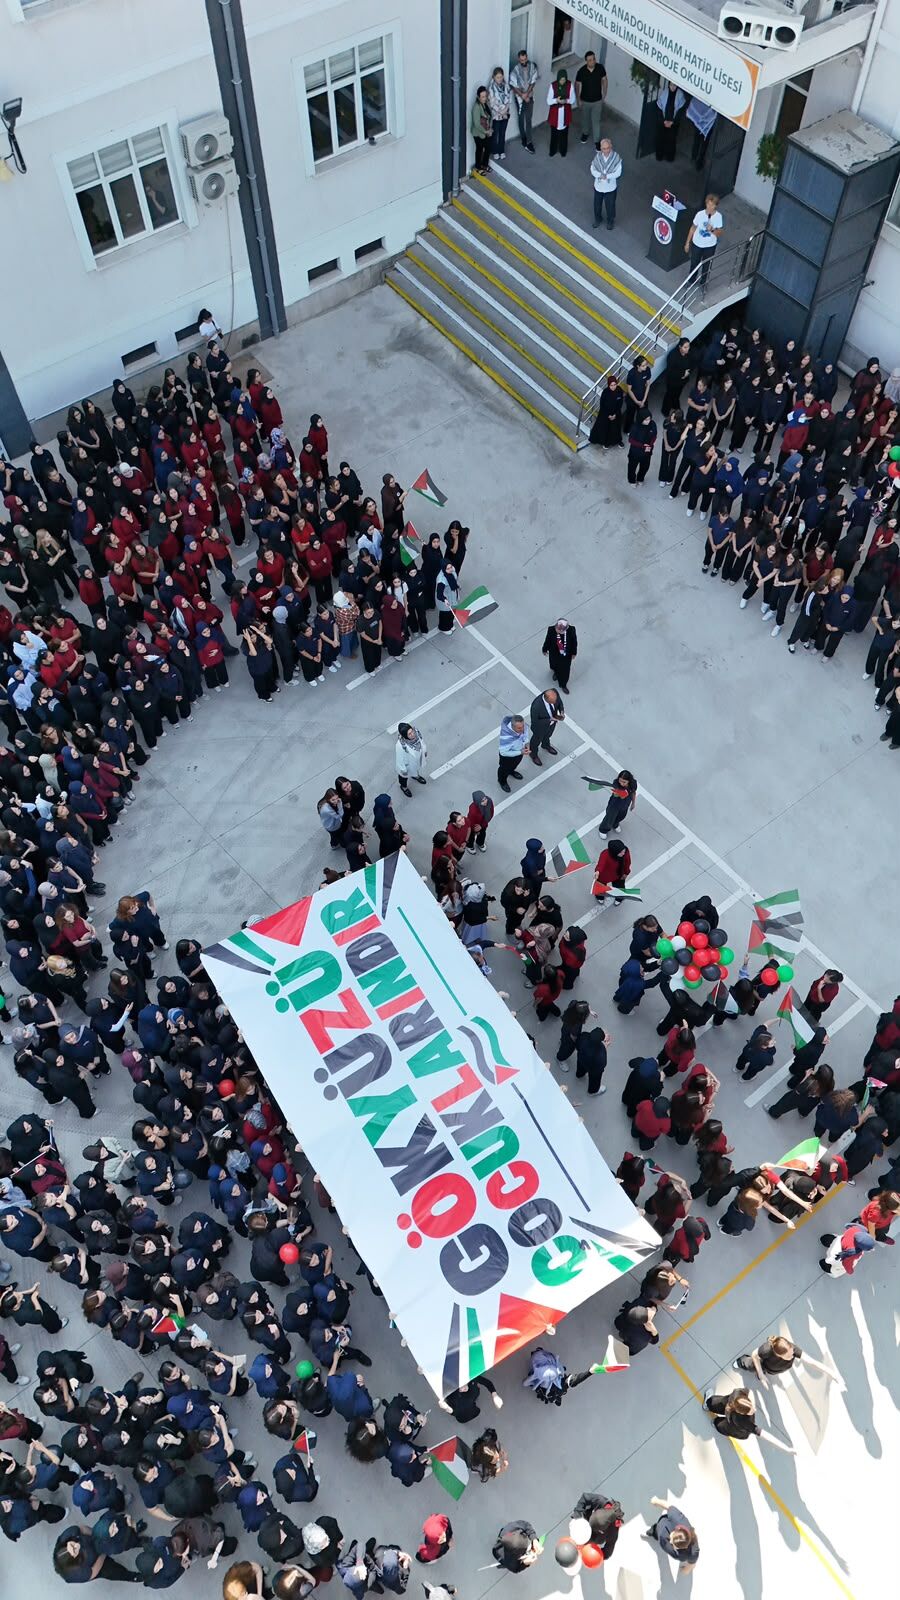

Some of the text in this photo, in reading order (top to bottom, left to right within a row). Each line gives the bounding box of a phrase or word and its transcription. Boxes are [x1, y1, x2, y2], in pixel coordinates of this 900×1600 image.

[577, 1, 608, 29] SOSYAL
[610, 21, 649, 55] BİLİMLER
[651, 47, 679, 74] PROJE
[680, 66, 712, 95] OKULU
[610, 4, 655, 39] ANADOLU
[656, 29, 683, 58] İMAM
[684, 49, 712, 74] HATİP
[713, 67, 743, 95] LİSESİ
[265, 949, 509, 1297] GÖKYÜZÜ
[320, 887, 591, 1288] ÇOCUKLARINDIR
